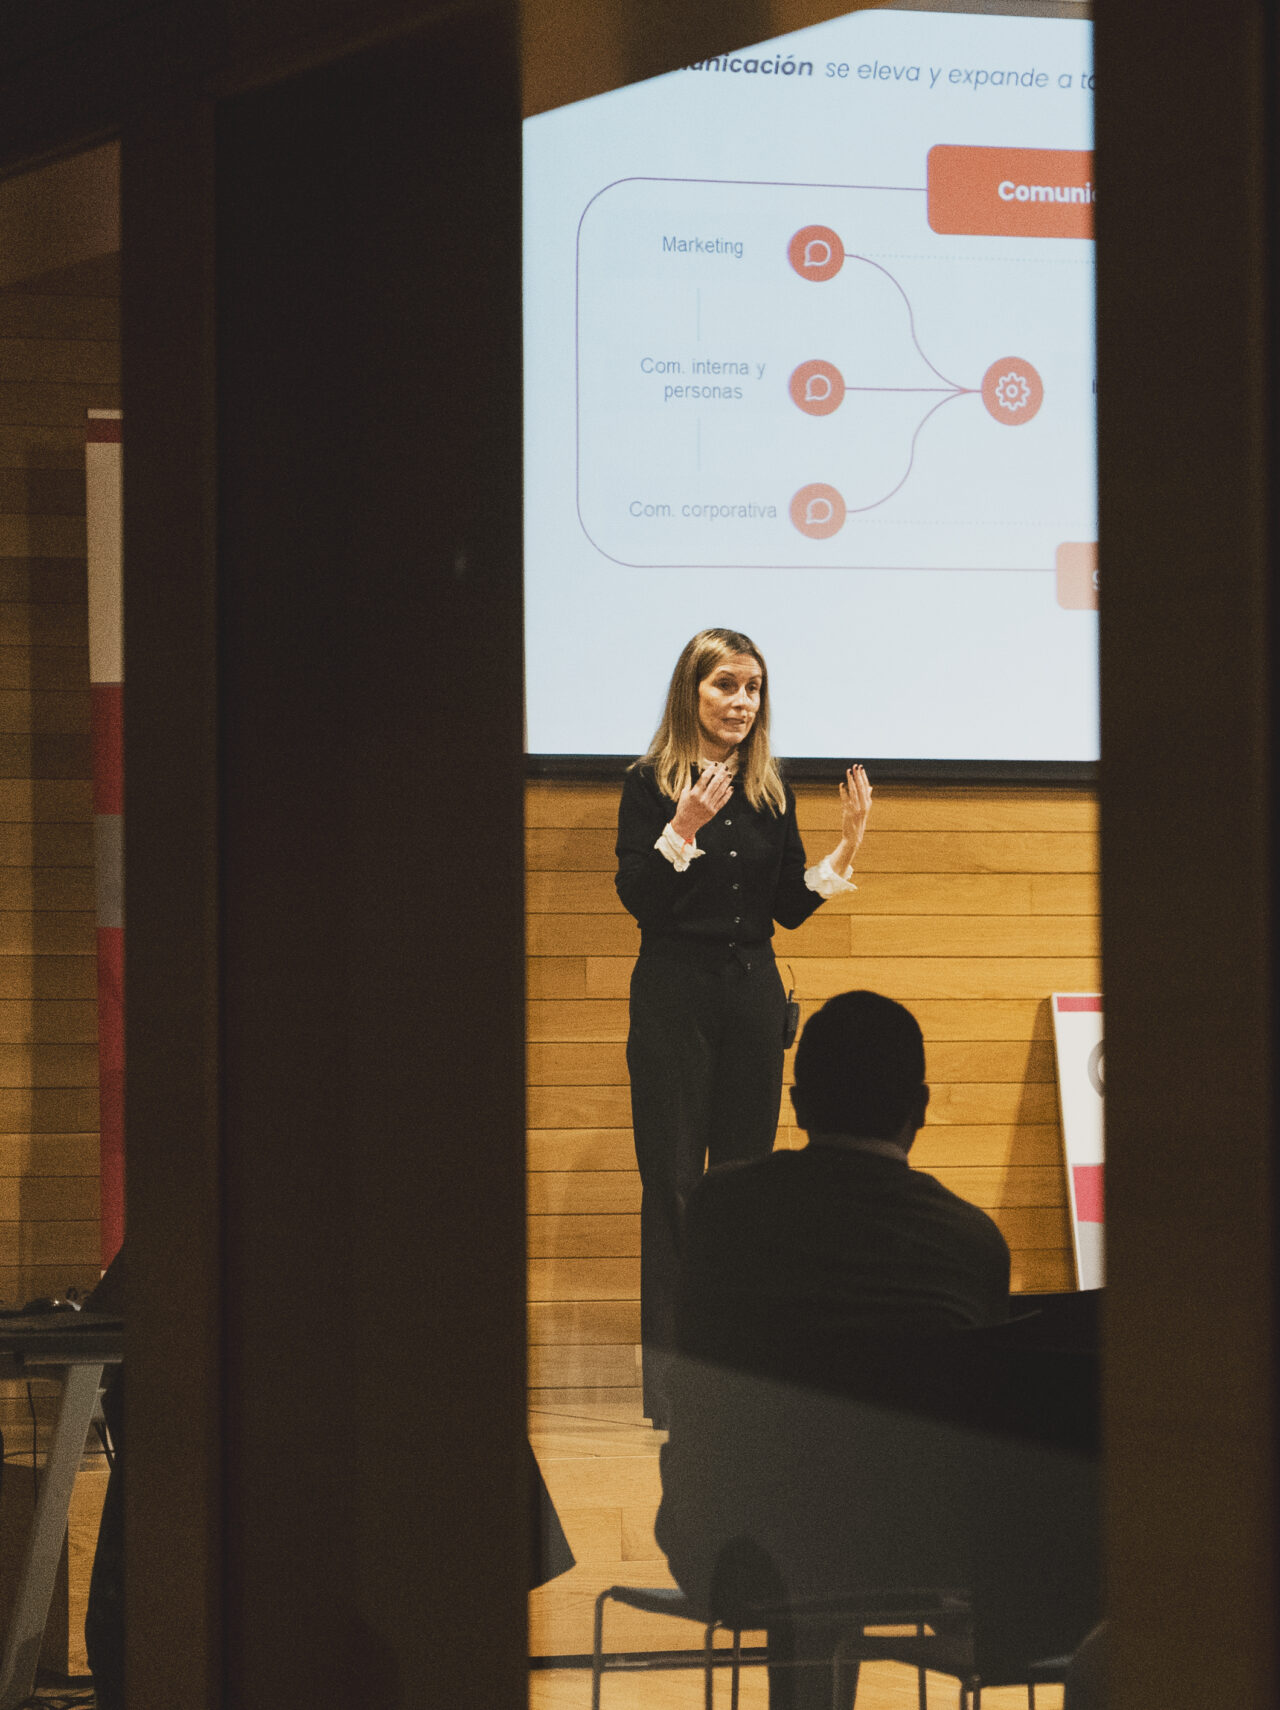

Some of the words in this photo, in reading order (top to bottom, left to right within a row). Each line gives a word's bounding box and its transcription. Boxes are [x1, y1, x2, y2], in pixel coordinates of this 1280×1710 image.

[824, 61, 850, 78] se
[857, 60, 920, 82] eleva
[929, 67, 942, 89] y
[948, 67, 1049, 91] expande
[1057, 73, 1072, 89] a
[997, 180, 1096, 204] Comuni
[662, 236, 744, 259] Marketing
[640, 357, 685, 374] Com.
[692, 359, 749, 375] interna
[756, 362, 766, 380] y
[664, 384, 743, 402] personas
[629, 501, 675, 518] Com.
[681, 503, 777, 521] corporativa
